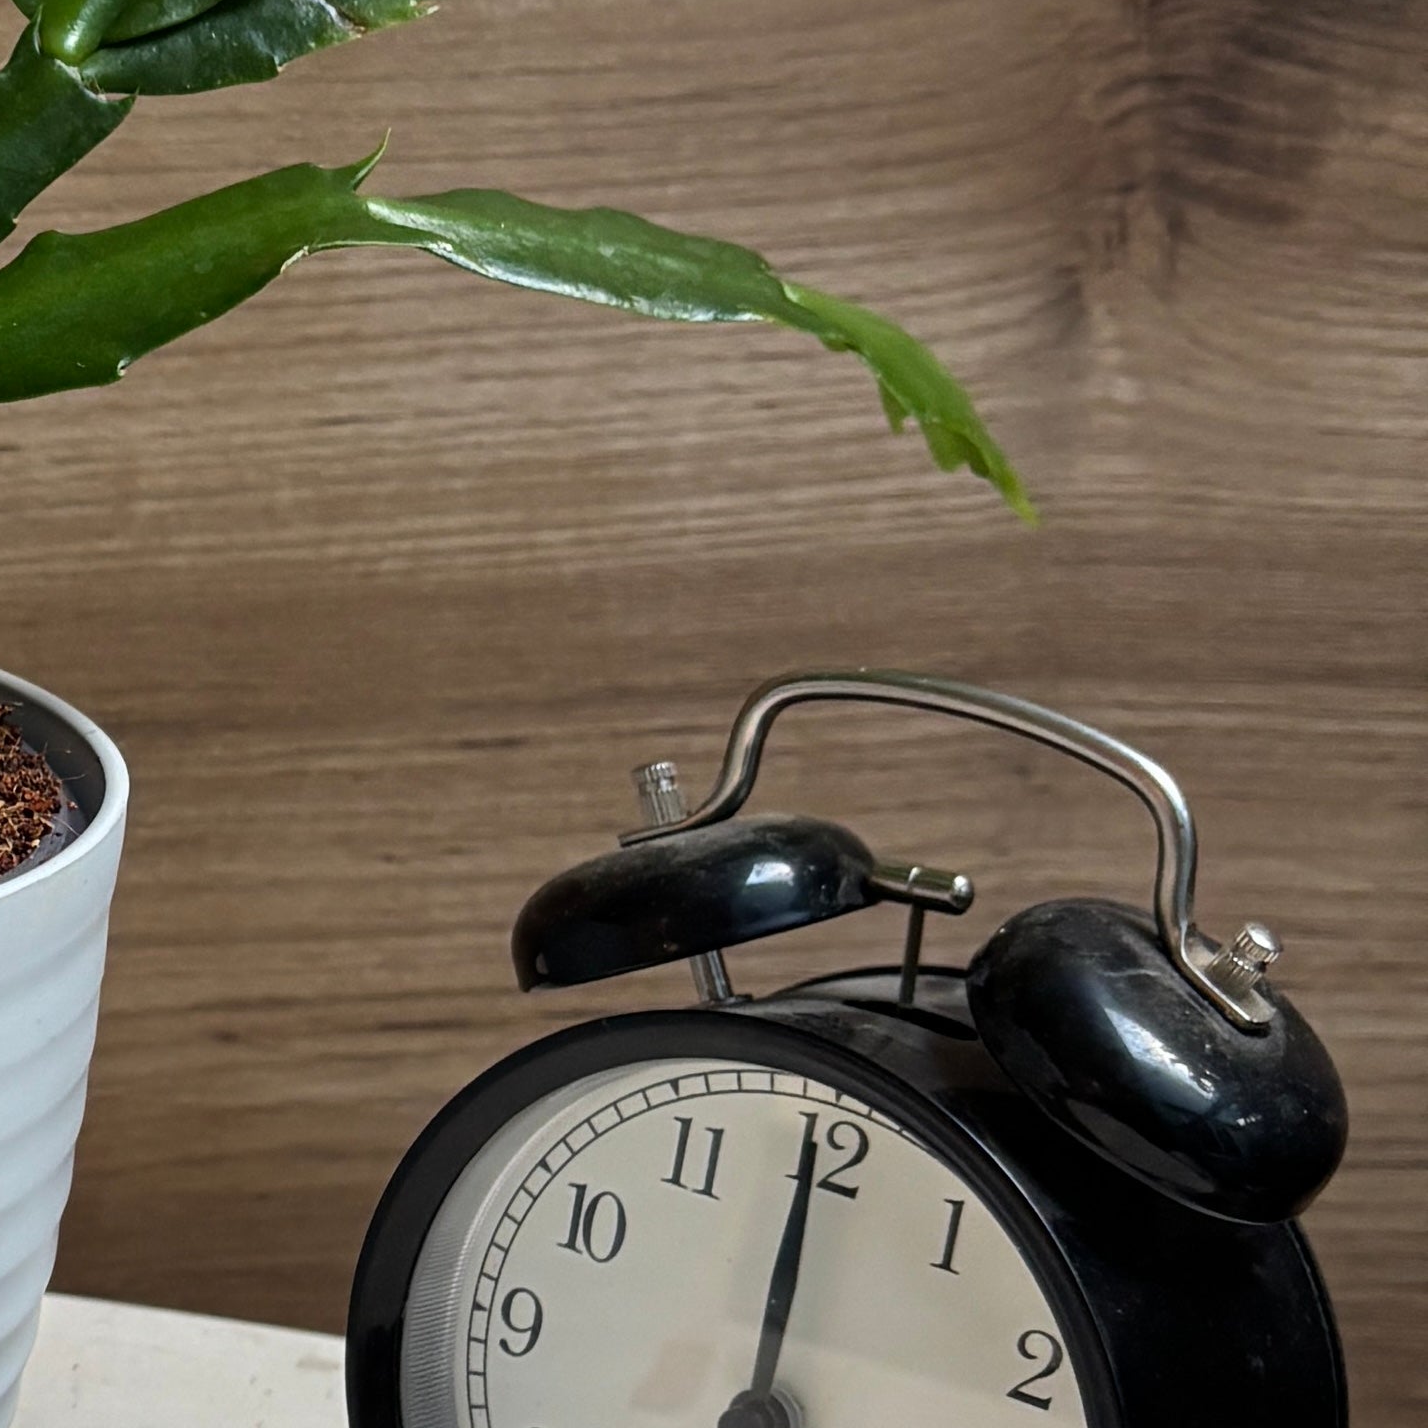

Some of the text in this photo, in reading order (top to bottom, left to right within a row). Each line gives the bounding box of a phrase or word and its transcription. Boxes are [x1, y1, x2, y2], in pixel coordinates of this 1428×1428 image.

[660, 1115, 725, 1200] 11
[784, 1110, 871, 1200] 12
[556, 1182, 627, 1263] 10
[929, 1197, 966, 1276] 1
[498, 1287, 544, 1357] 9
[1006, 1329, 1064, 1411] 2
